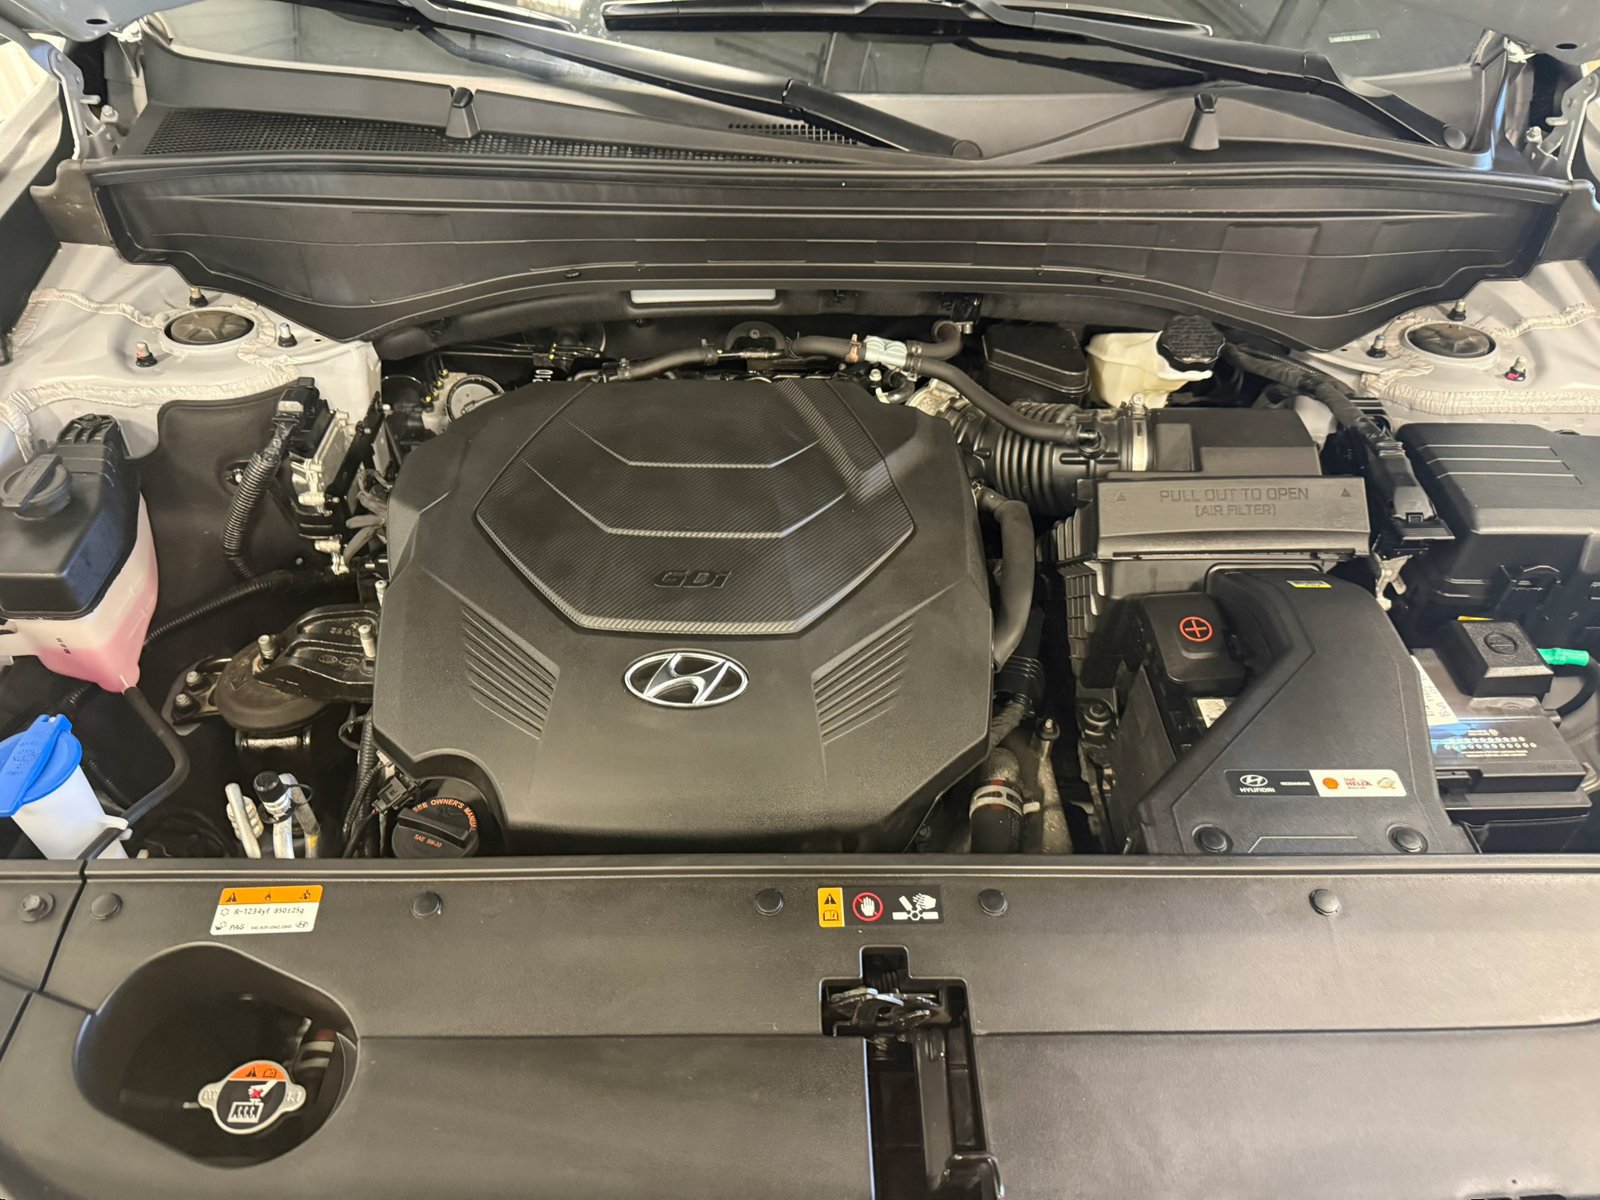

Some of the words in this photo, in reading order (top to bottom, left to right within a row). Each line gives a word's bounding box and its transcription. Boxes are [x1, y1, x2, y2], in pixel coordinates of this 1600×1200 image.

[1159, 489, 1201, 503] PULL
[1204, 488, 1238, 502] OUT
[1240, 487, 1262, 501] TO
[1266, 487, 1309, 501] OPEN
[413, 801, 429, 813] SEE
[430, 798, 465, 809] OWNER'S
[413, 833, 426, 842] SAE
